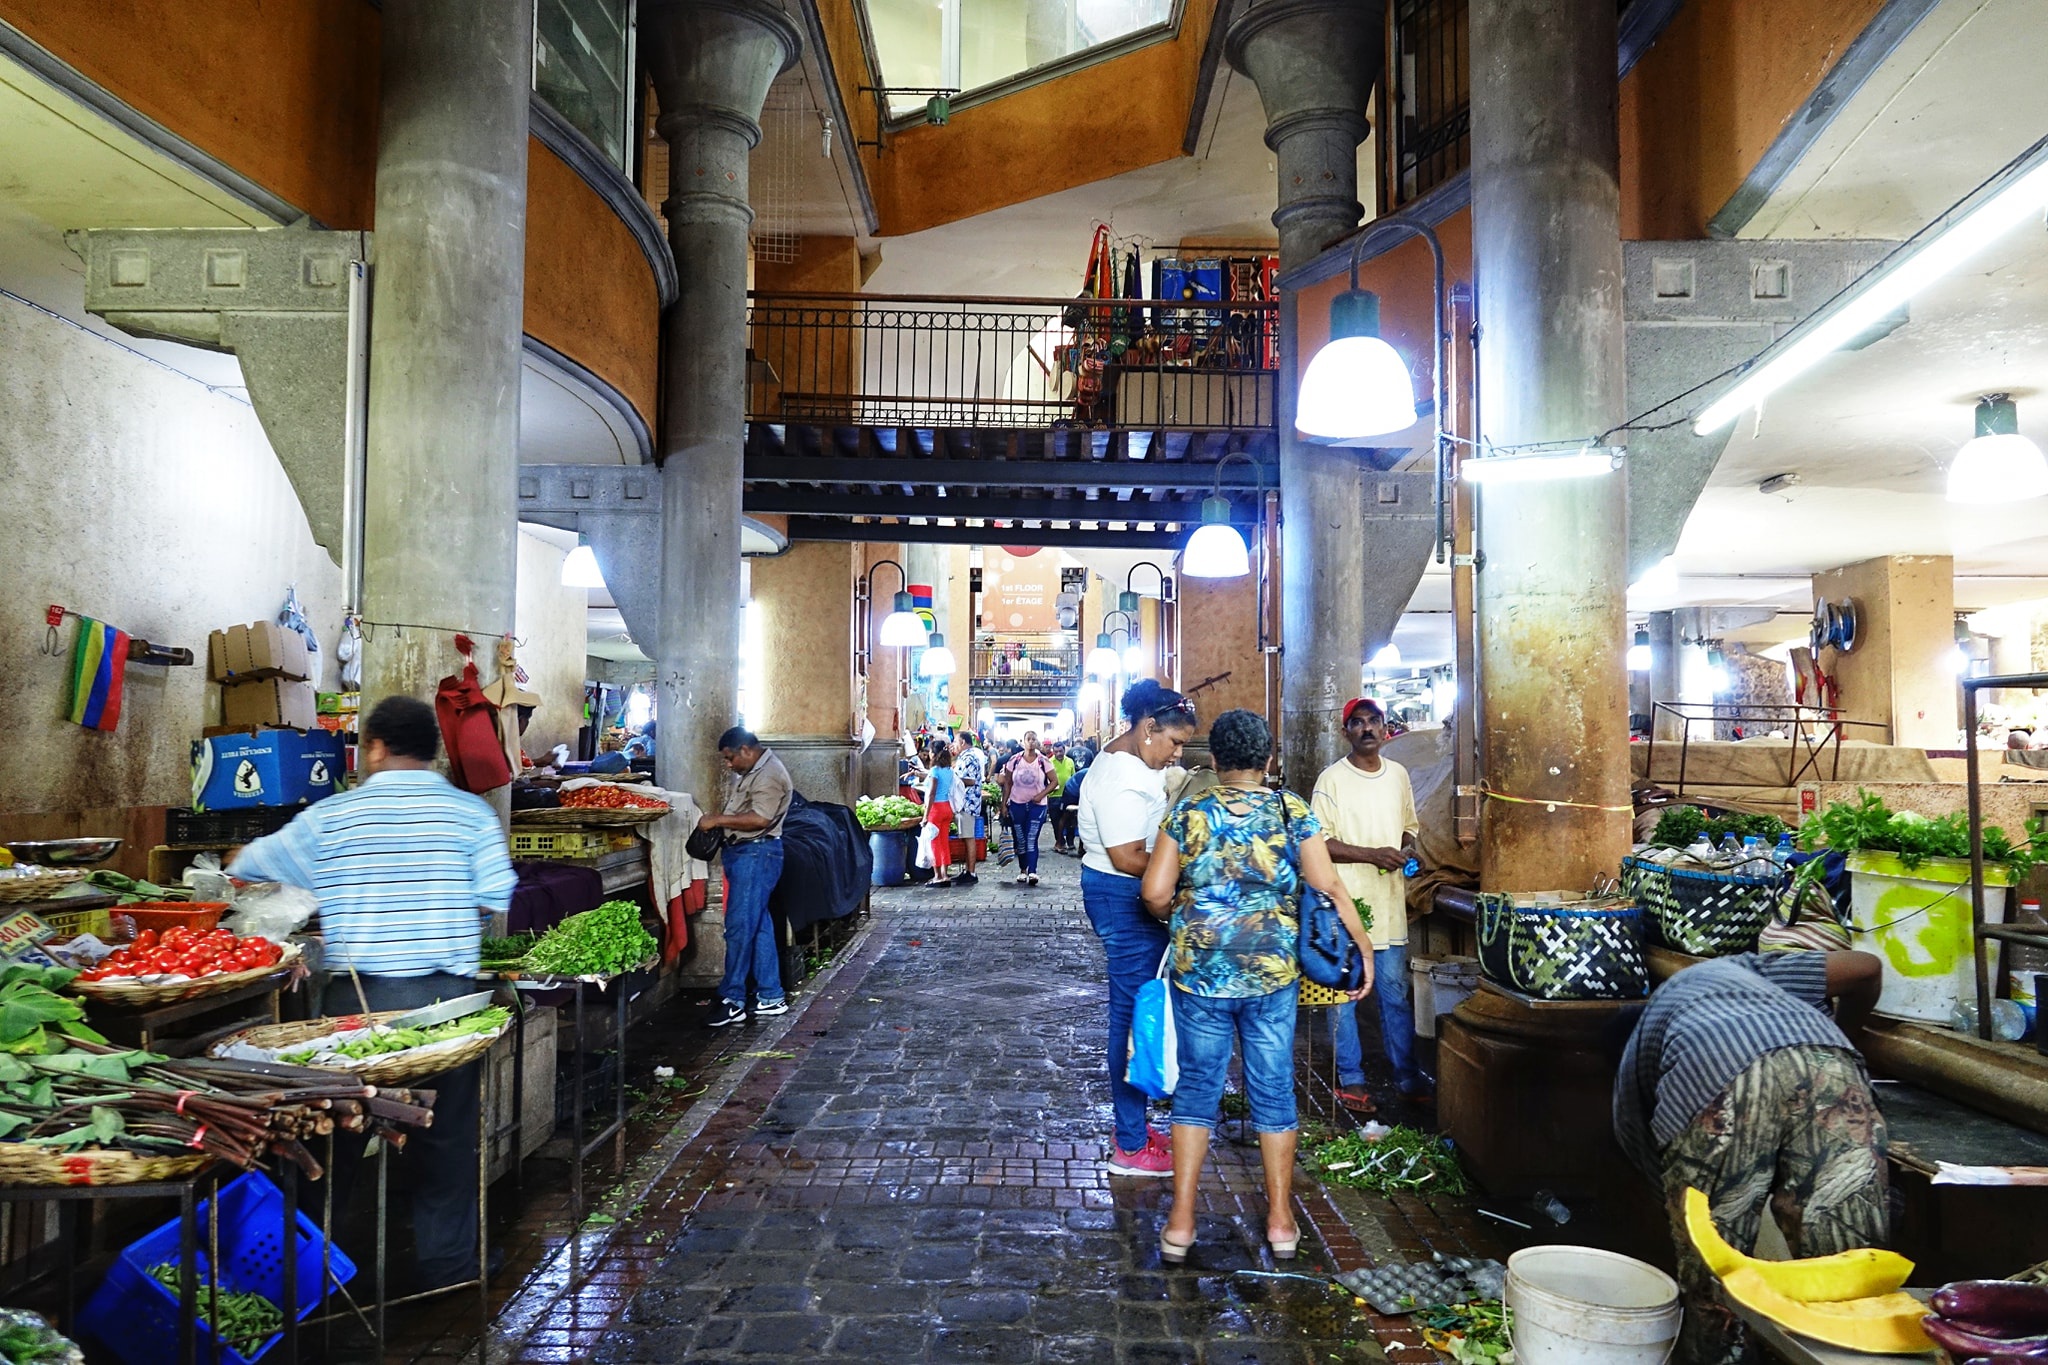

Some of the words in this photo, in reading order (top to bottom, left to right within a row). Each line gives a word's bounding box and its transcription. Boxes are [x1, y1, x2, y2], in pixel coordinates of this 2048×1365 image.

[1002, 584, 1014, 592] 1st
[1015, 584, 1044, 592] FLOOR
[1002, 597, 1014, 605] 1er
[1015, 596, 1043, 605] ÉTAGE
